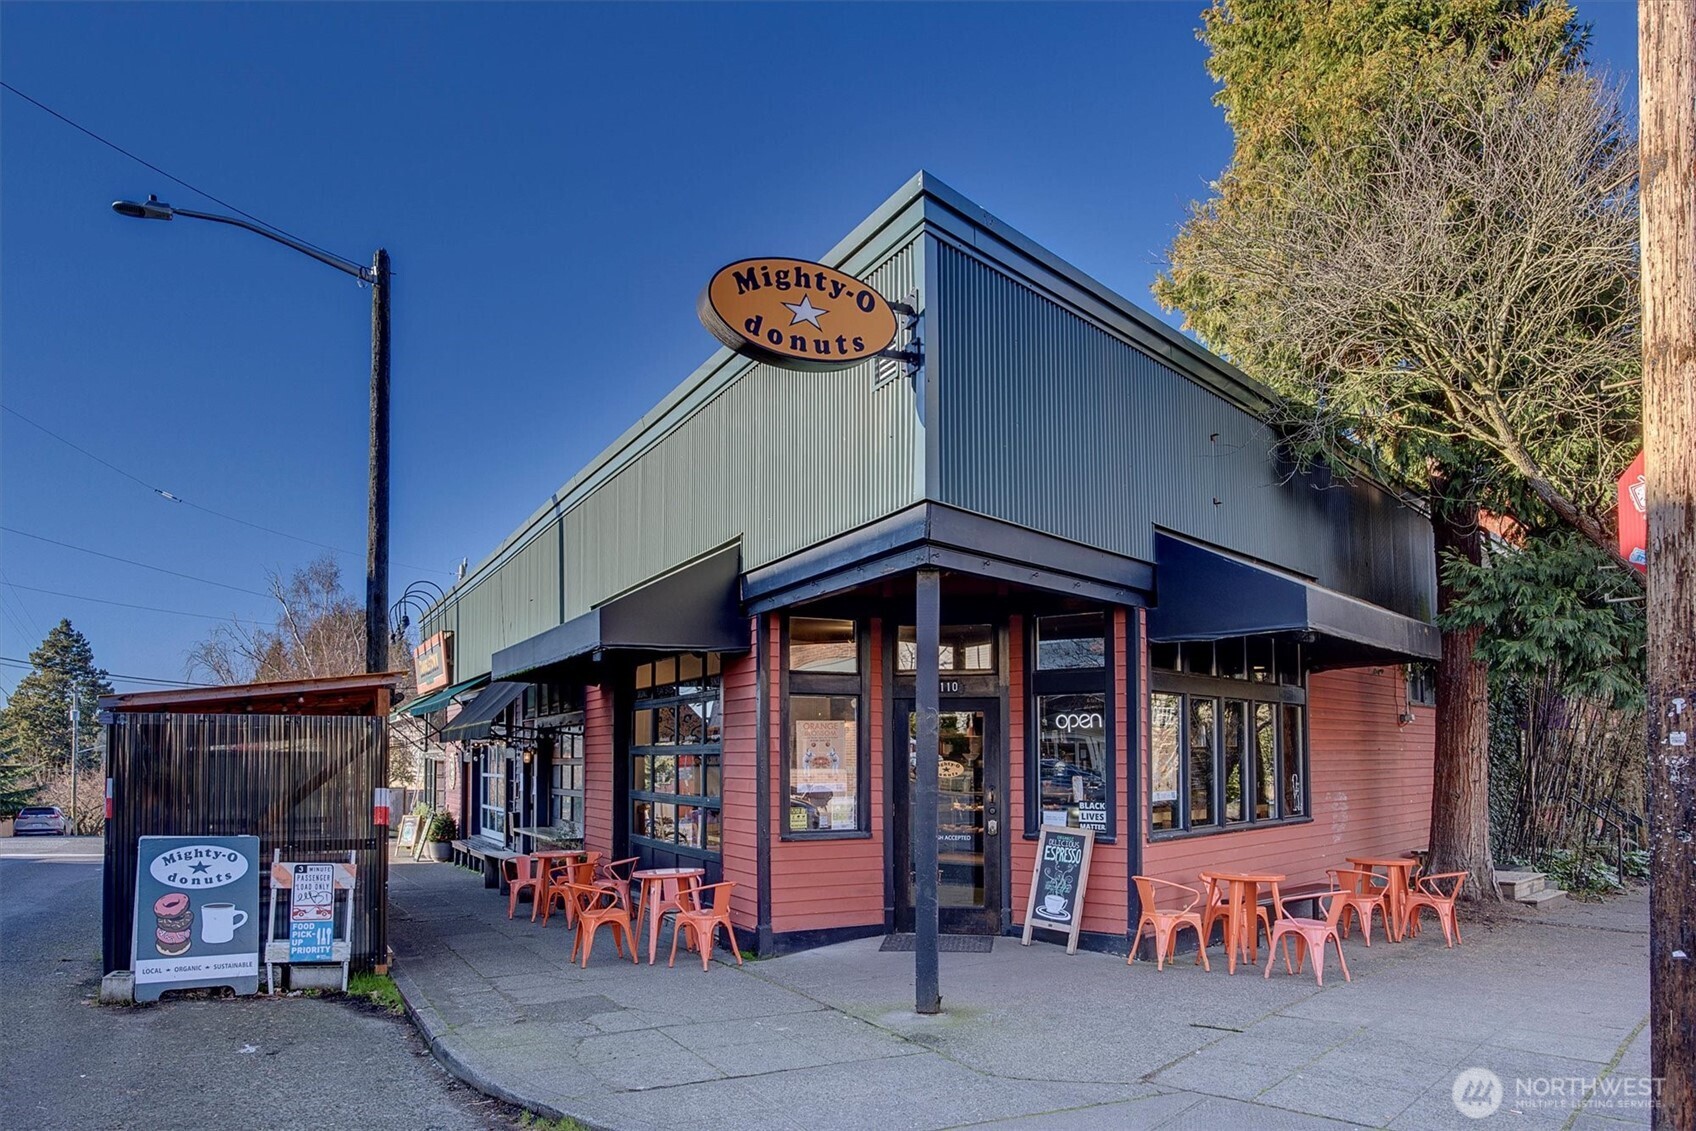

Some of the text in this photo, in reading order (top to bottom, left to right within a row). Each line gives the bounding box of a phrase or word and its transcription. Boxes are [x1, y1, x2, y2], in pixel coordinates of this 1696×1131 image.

[732, 265, 876, 313] Mighty-O
[744, 315, 866, 354] donuts
[803, 722, 838, 730] ORANGE
[1055, 713, 1102, 733] open
[1079, 802, 1105, 810] BLACK
[1081, 811, 1104, 820] LIVES
[1048, 838, 1080, 848] DELICIOUS
[161, 848, 238, 866] Mighty-O
[1044, 846, 1081, 864] ESPRESSO
[167, 872, 232, 885] donuts
[292, 930, 316, 938] PICK-
[291, 938, 304, 946] UP
[291, 946, 331, 954] PRIORITY
[213, 961, 253, 970] SUSTAINABLE
